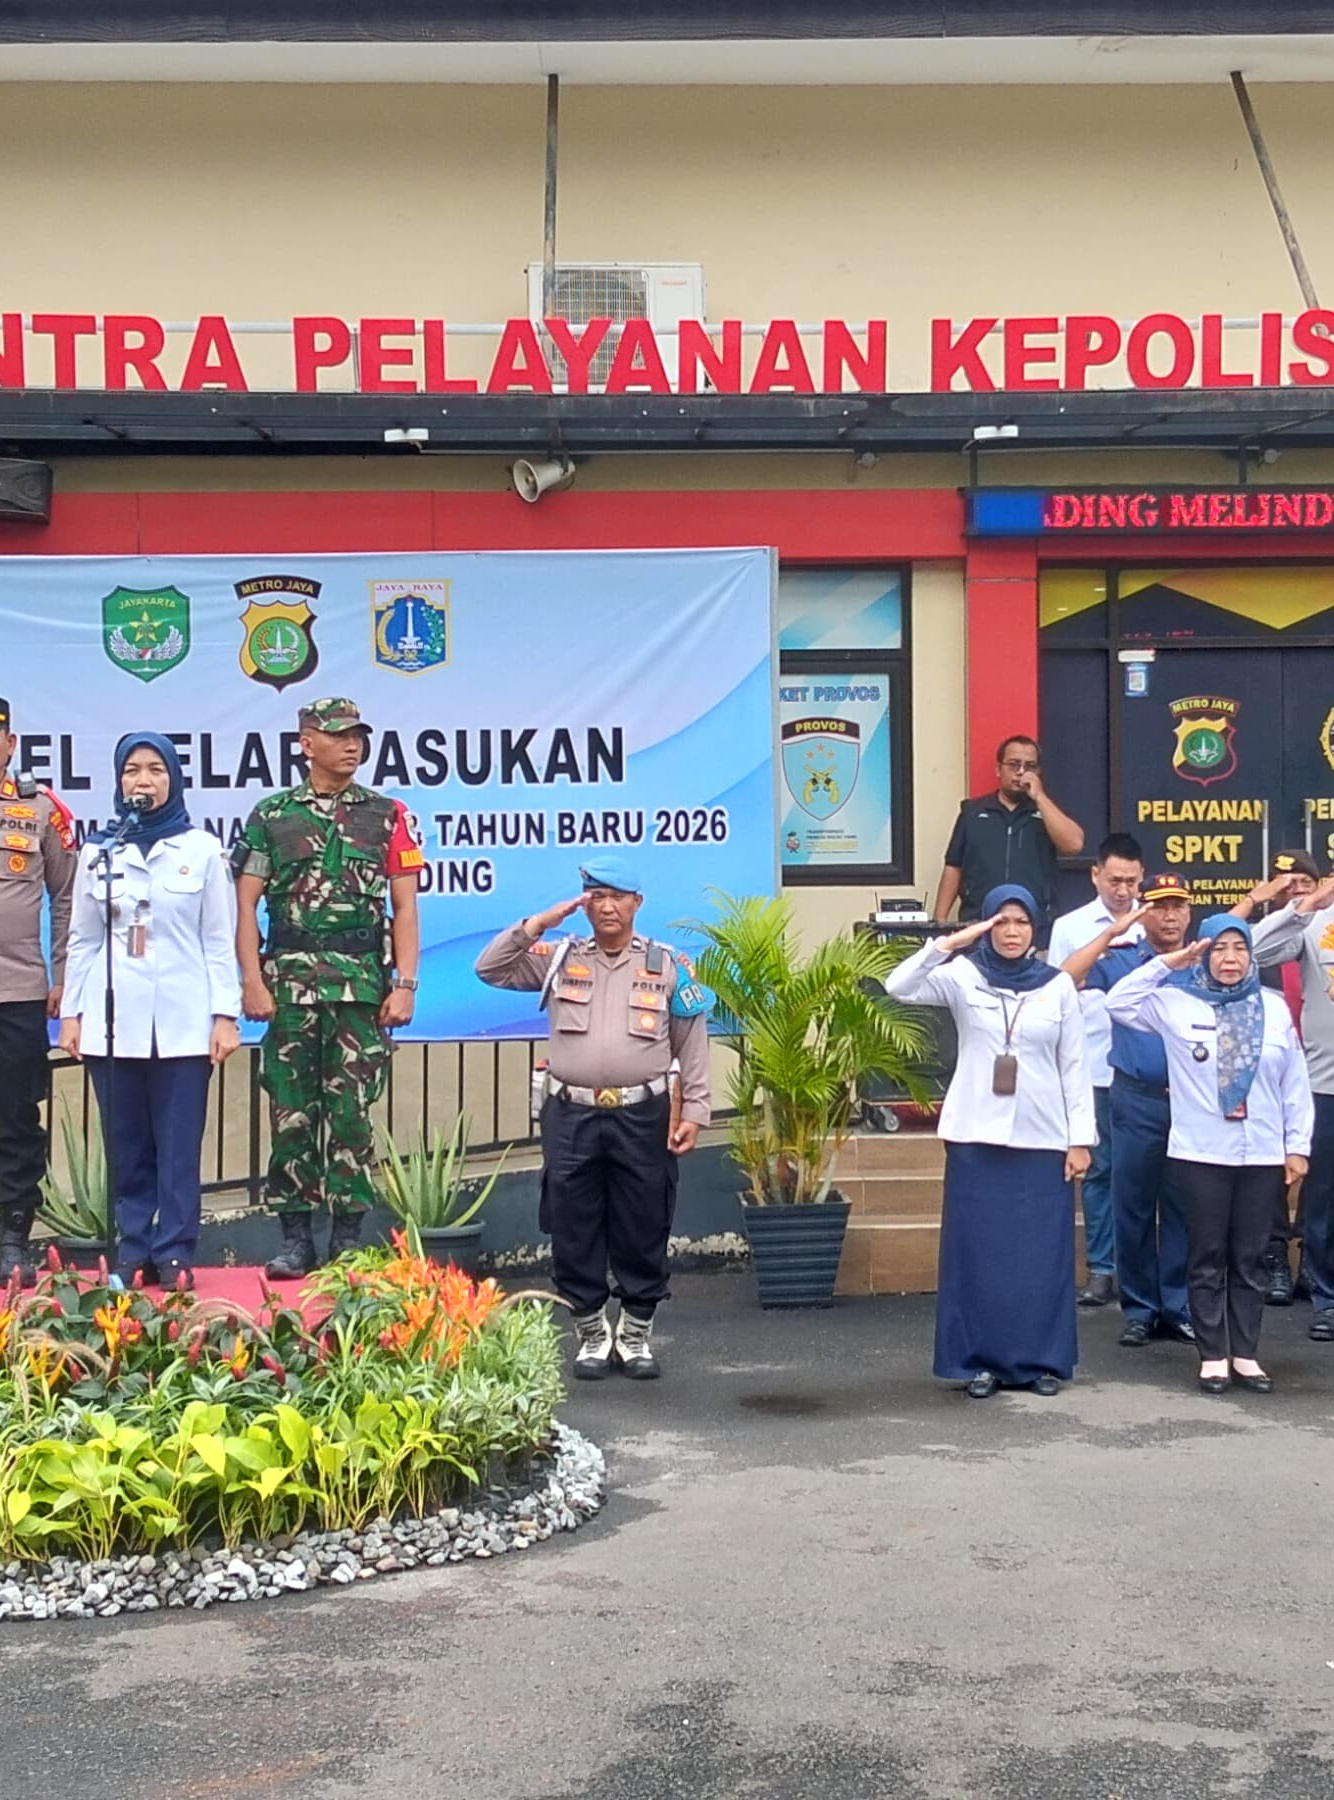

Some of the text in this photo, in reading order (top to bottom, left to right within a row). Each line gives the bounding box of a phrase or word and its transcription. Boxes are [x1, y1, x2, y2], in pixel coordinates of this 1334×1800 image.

[293, 316, 887, 395] PELAYANAN
[1044, 493, 1160, 528] DING
[240, 579, 314, 595] METRO JAYA
[375, 583, 443, 592] JAYA RAYA
[118, 597, 176, 610] JAYAKARTA
[813, 685, 881, 702] PROVOS
[1172, 698, 1235, 713] METRO JAYA
[794, 720, 847, 732] PROVOS
[179, 731, 309, 789] ELAR
[435, 812, 545, 846] TAHUN
[557, 810, 644, 845] BARU
[655, 808, 727, 842] 2026
[1166, 834, 1244, 863] SPKT
[632, 980, 667, 993] POLRI
